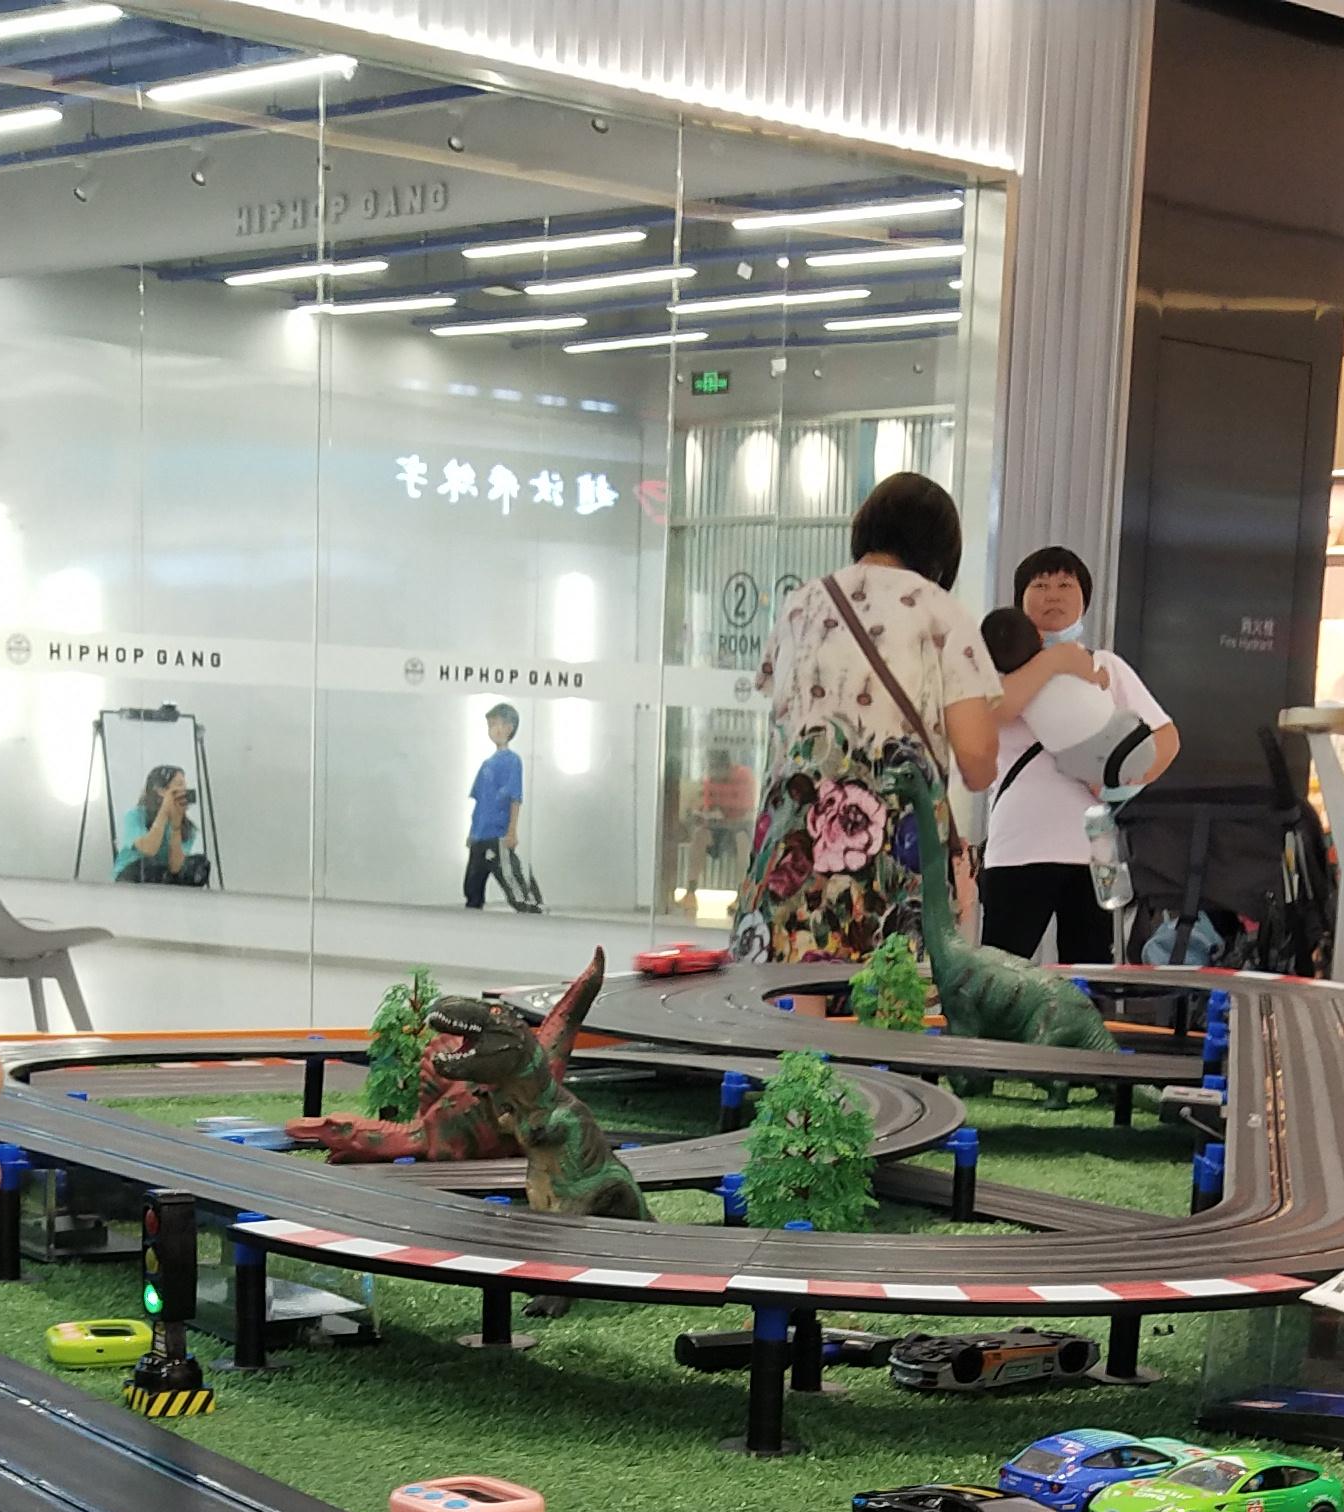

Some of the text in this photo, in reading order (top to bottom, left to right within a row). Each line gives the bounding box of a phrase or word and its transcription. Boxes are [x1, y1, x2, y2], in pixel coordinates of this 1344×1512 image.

[733, 583, 747, 619] 2
[49, 642, 144, 664] HIPHOP
[719, 635, 761, 656] ROOM
[439, 665, 519, 684] HIPHOP
